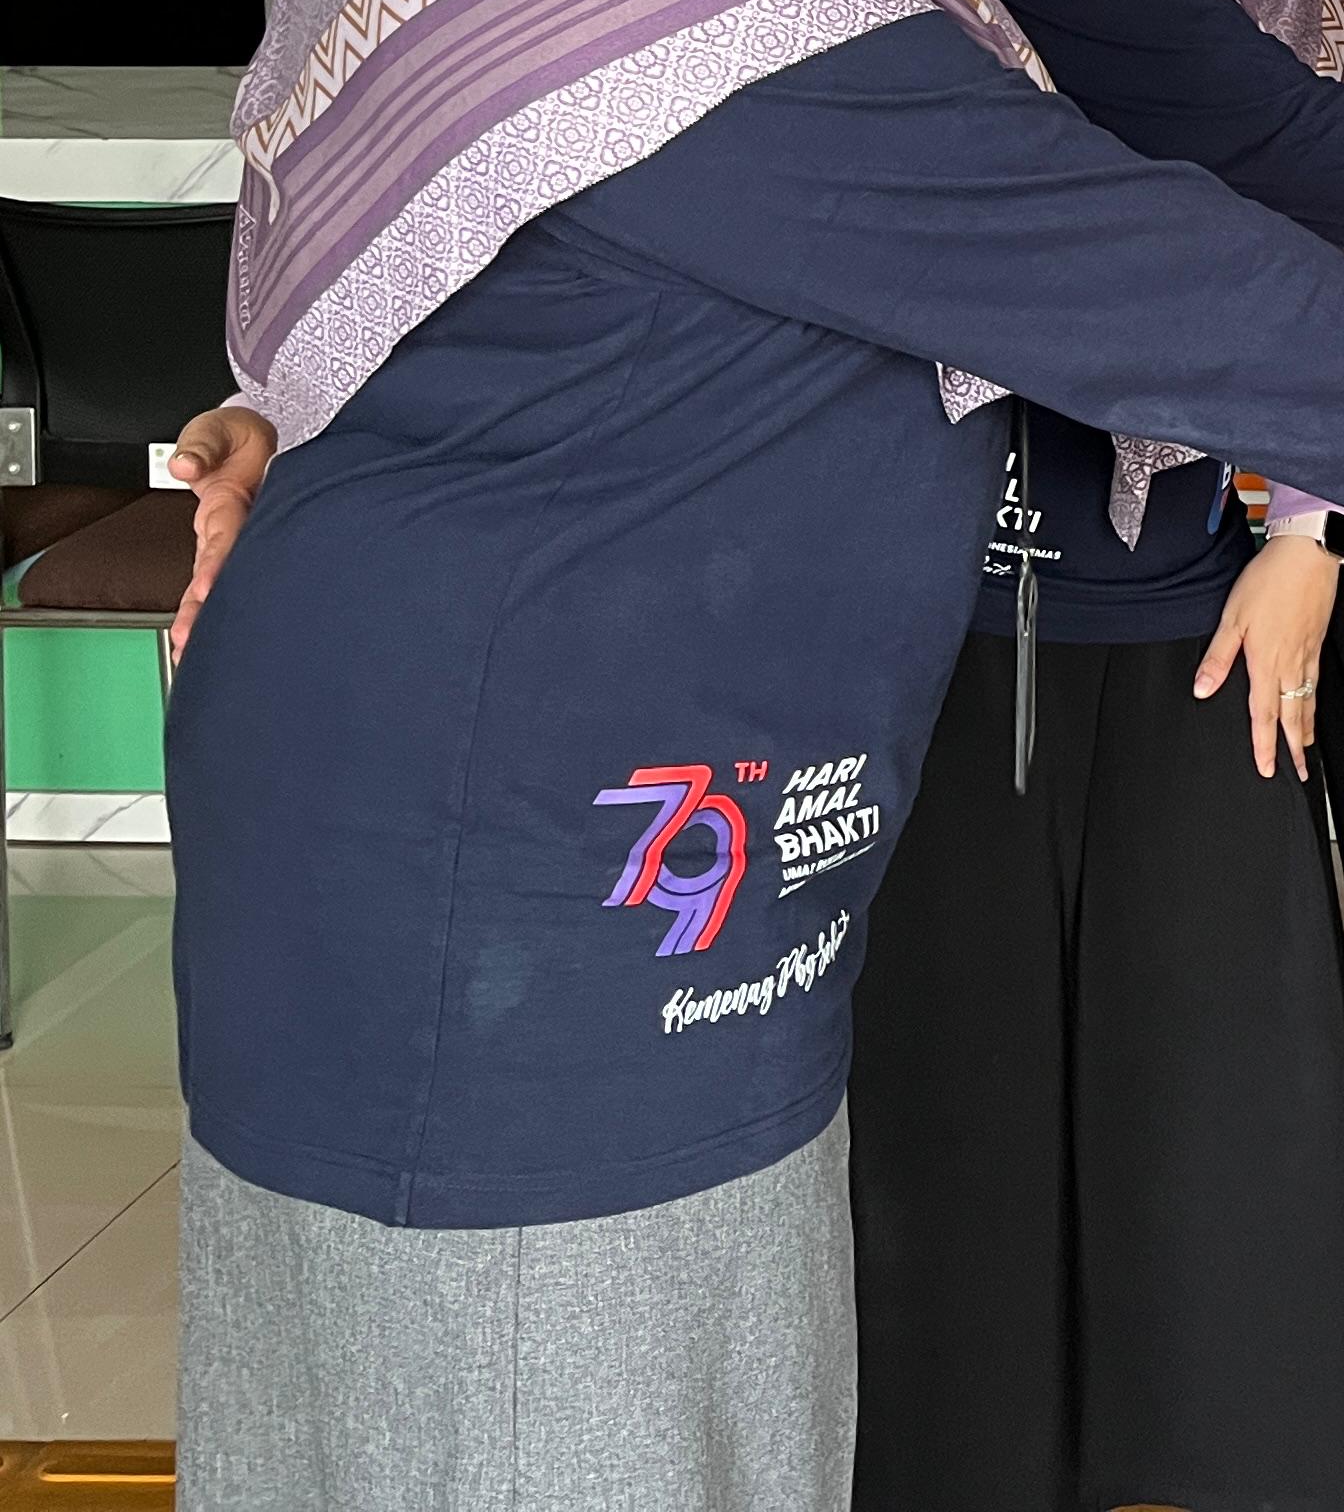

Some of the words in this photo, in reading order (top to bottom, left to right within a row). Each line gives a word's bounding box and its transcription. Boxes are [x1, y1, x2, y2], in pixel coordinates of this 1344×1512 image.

[734, 759, 768, 783] TH
[782, 753, 868, 795] HARI
[773, 782, 862, 831] AMAL
[773, 804, 880, 863] BHAKTI
[662, 975, 776, 1034] Kemenag
